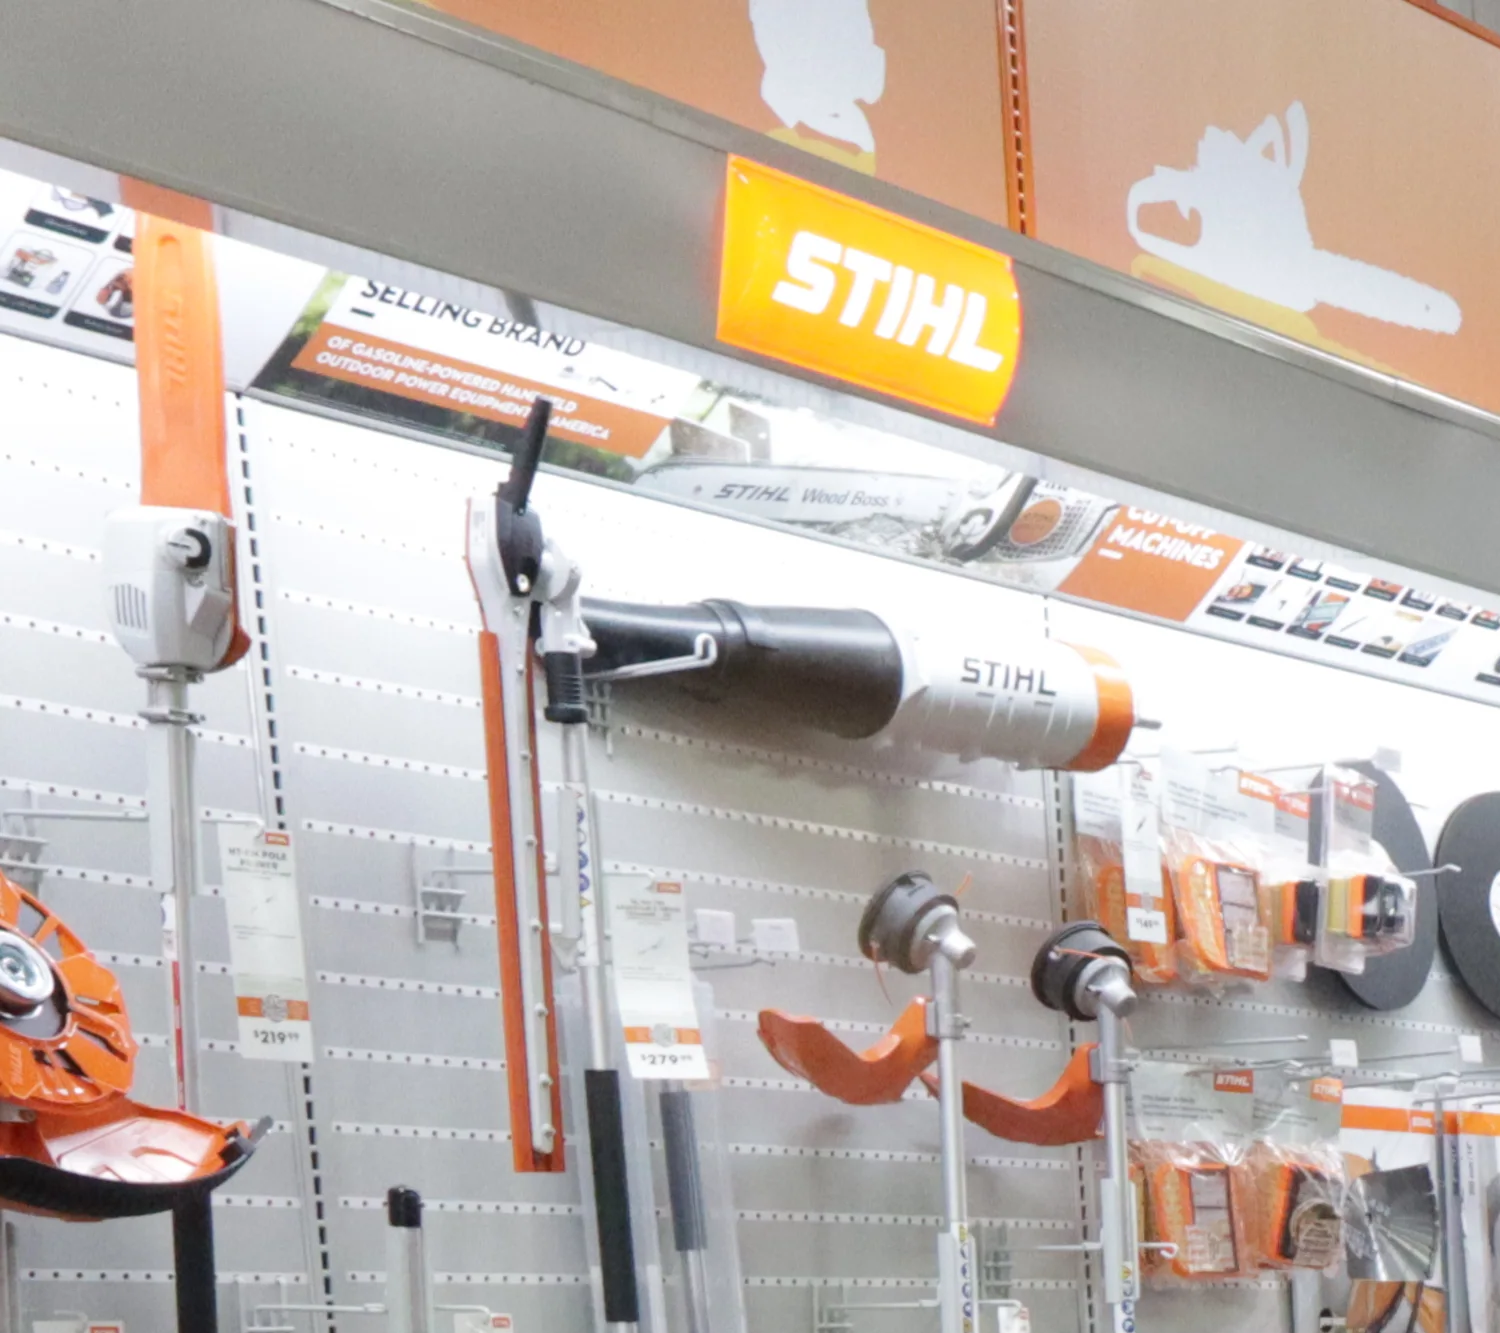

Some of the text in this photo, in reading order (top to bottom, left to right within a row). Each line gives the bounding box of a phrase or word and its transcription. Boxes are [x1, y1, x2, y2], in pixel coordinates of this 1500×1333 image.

[361, 280, 587, 357] SELLING BRAND
[771, 231, 1004, 373] STIHL
[327, 336, 350, 352] OF
[351, 342, 501, 393] GASOLINE-POWERED
[315, 352, 611, 441] OUTDOOR POWER EQUIPMENT AMERICA
[713, 482, 889, 508] STIHL Wood Boss
[1106, 524, 1225, 571] MACHINES
[960, 657, 1057, 698] STIHL
[1215, 1074, 1251, 1088] STIHL
